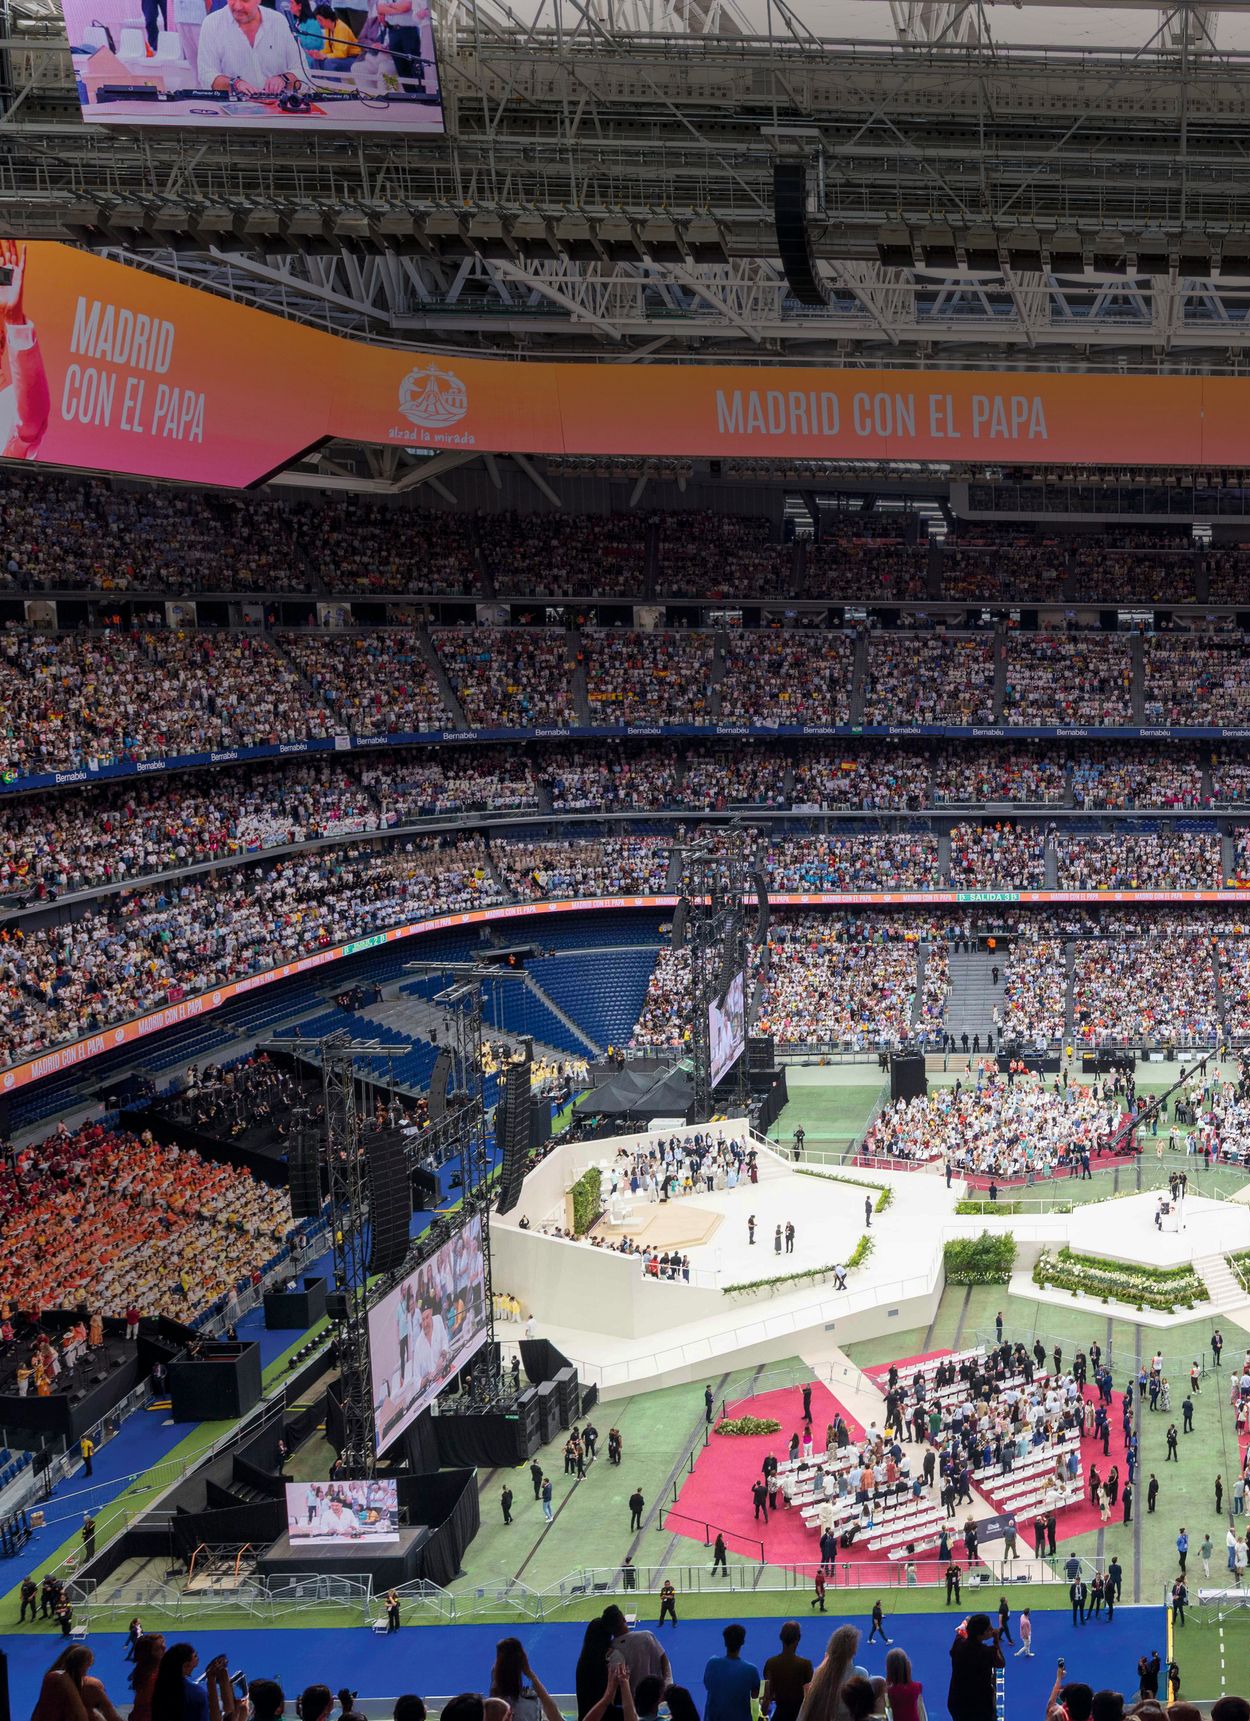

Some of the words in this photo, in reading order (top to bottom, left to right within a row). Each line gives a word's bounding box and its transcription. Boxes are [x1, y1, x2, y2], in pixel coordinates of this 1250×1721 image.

[71, 296, 174, 374] MADRID
[62, 364, 116, 427] CON
[120, 377, 144, 432] EL
[152, 384, 206, 443] PAPA
[716, 390, 840, 436] MADRID
[853, 392, 916, 438] CON
[928, 394, 960, 438] EL
[972, 395, 1048, 440] PAPA
[388, 427, 417, 440] alzad
[421, 429, 430, 440] la
[434, 432, 475, 444] mirada
[280, 744, 307, 752] Bernabéu
[357, 736, 387, 745] Bernabéu
[137, 760, 165, 771] Bernabéu
[211, 752, 237, 762] Bernabéu
[56, 771, 86, 782] Bernabéu
[138, 1015, 163, 1035] MADRID
[165, 1009, 178, 1024] CON
[180, 1006, 186, 1018] EL
[188, 1000, 202, 1015] PAPA
[32, 1056, 60, 1078] MADRID
[62, 1049, 76, 1066] CON
[78, 1046, 85, 1059] EL
[88, 1038, 104, 1055] PAPA
